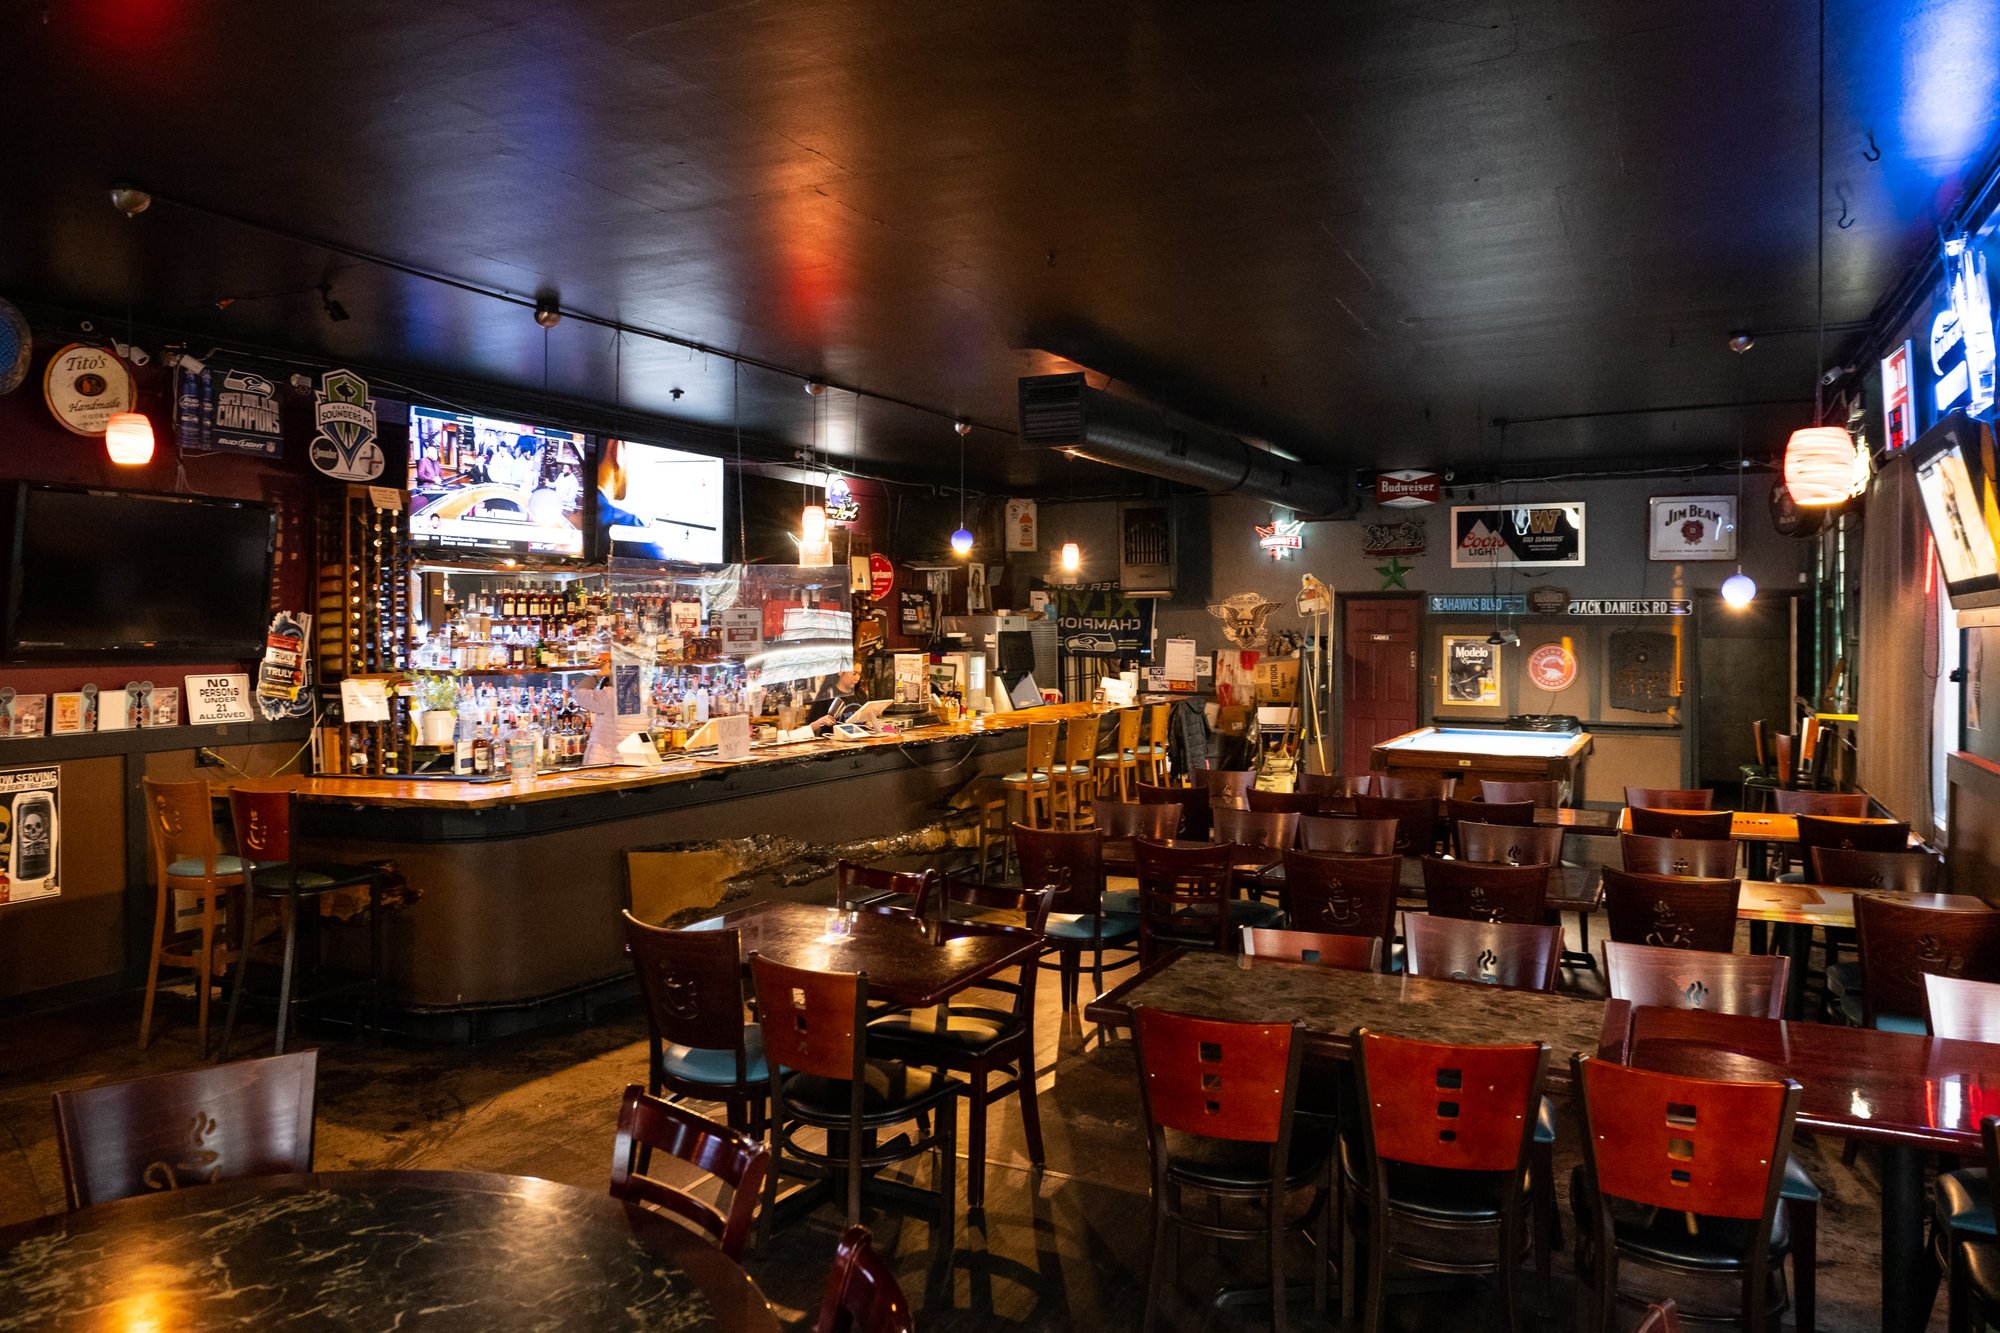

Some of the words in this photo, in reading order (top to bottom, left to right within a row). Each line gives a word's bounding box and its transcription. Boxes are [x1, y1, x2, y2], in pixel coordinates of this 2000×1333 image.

[65, 355, 107, 371] Tito's
[68, 398, 121, 413] Handmade
[216, 405, 281, 434] CHAMPIONS
[321, 410, 362, 421] SOUNDERS
[362, 417, 373, 429] FC
[240, 441, 264, 449] LIGHT
[1381, 480, 1434, 492] Budweiser
[1664, 508, 1687, 527] JIM
[1460, 532, 1506, 549] Coors
[1468, 547, 1499, 556] LIGHT
[1432, 598, 1479, 611] SEAHAWKS
[1480, 598, 1502, 611] BLVD
[1573, 601, 1601, 614] JACK
[1604, 601, 1650, 614] DANIELS
[1652, 601, 1668, 614] RD
[271, 649, 296, 661] TRULY
[1455, 647, 1489, 658] Modelo
[266, 666, 294, 678] TRULY
[1269, 664, 1279, 684] TOUCH
[207, 678, 229, 687] NO
[199, 687, 239, 697] PERSONS
[1270, 683, 1280, 698] SOFT
[204, 696, 237, 704] UNDER
[216, 703, 227, 712] 21
[199, 711, 246, 720] ALLOWED
[0, 774, 16, 785] OW
[16, 771, 57, 784] SERVING
[41, 780, 57, 788] CANS
